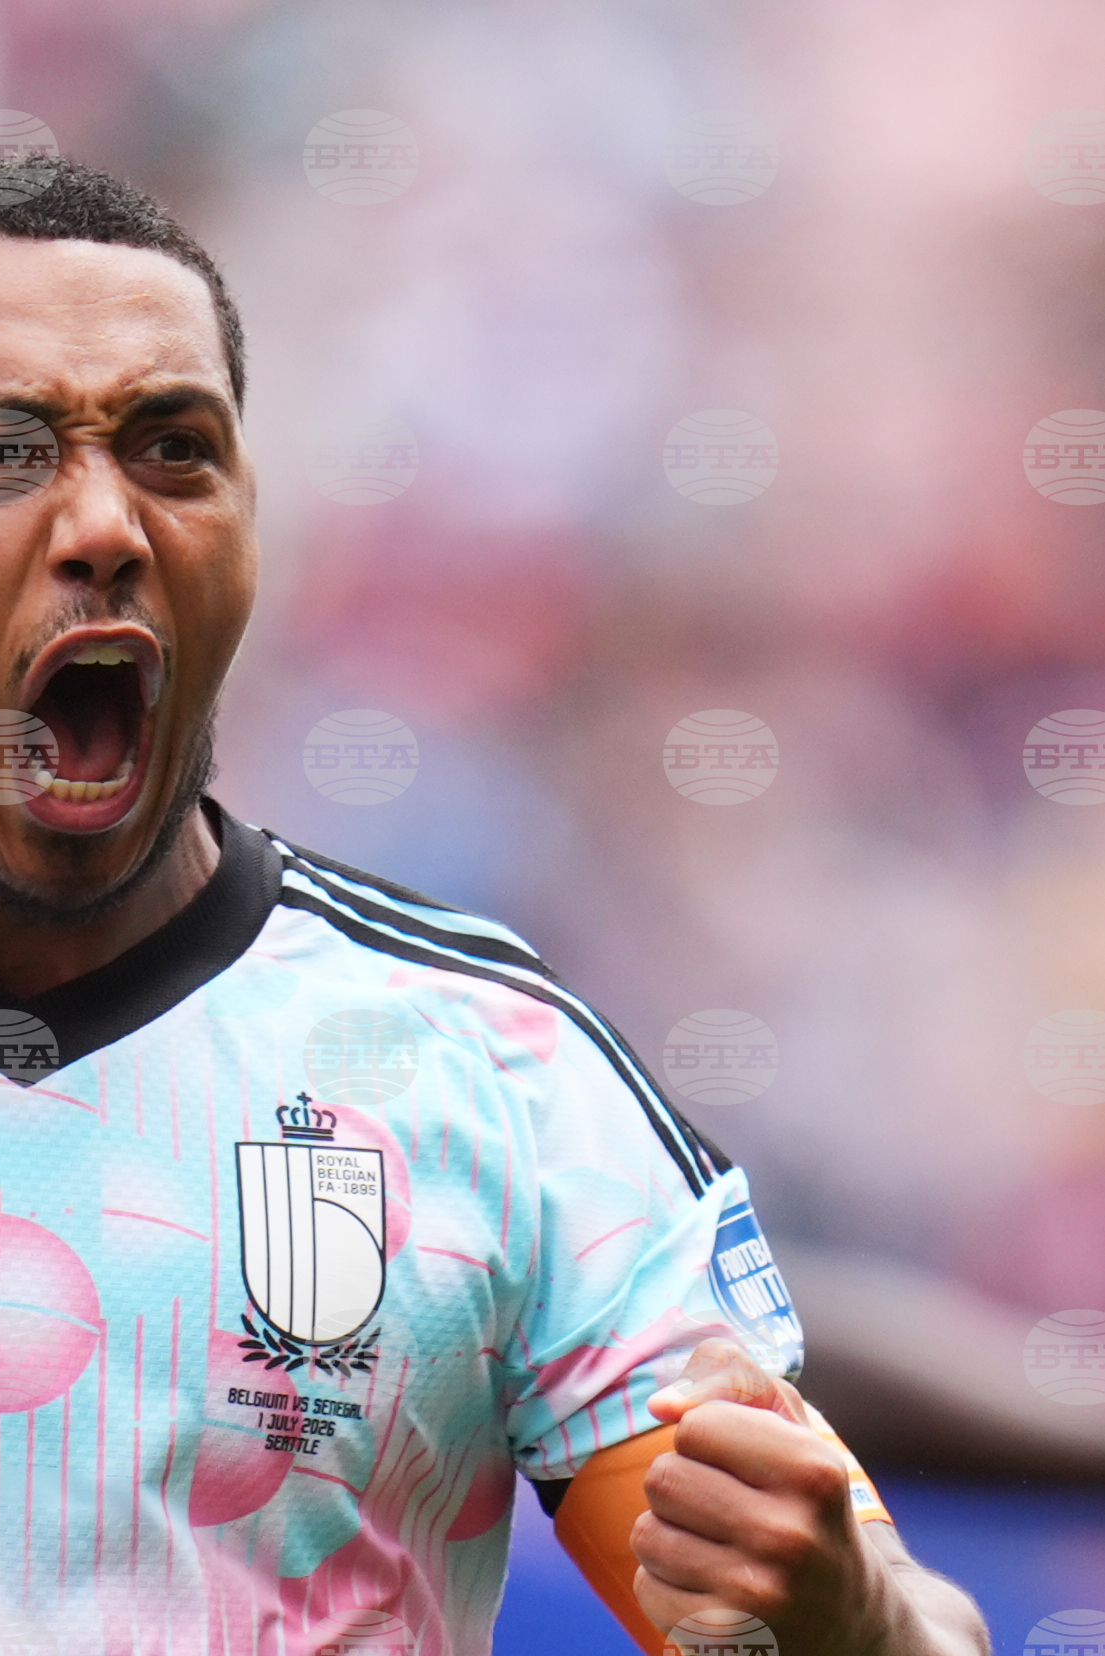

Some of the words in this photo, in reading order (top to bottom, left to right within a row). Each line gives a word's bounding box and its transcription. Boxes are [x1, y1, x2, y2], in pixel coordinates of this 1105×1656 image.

[317, 1155, 361, 1168] ROYAL
[318, 1168, 376, 1182] BELGIAN
[227, 1387, 289, 1410] BELGIUM
[292, 1396, 310, 1412] VS
[312, 1398, 362, 1420] SENEGAL
[257, 1412, 264, 1429] 1
[267, 1413, 299, 1432] JULY
[301, 1418, 336, 1436] 2026
[264, 1434, 321, 1455] SEATTLE
